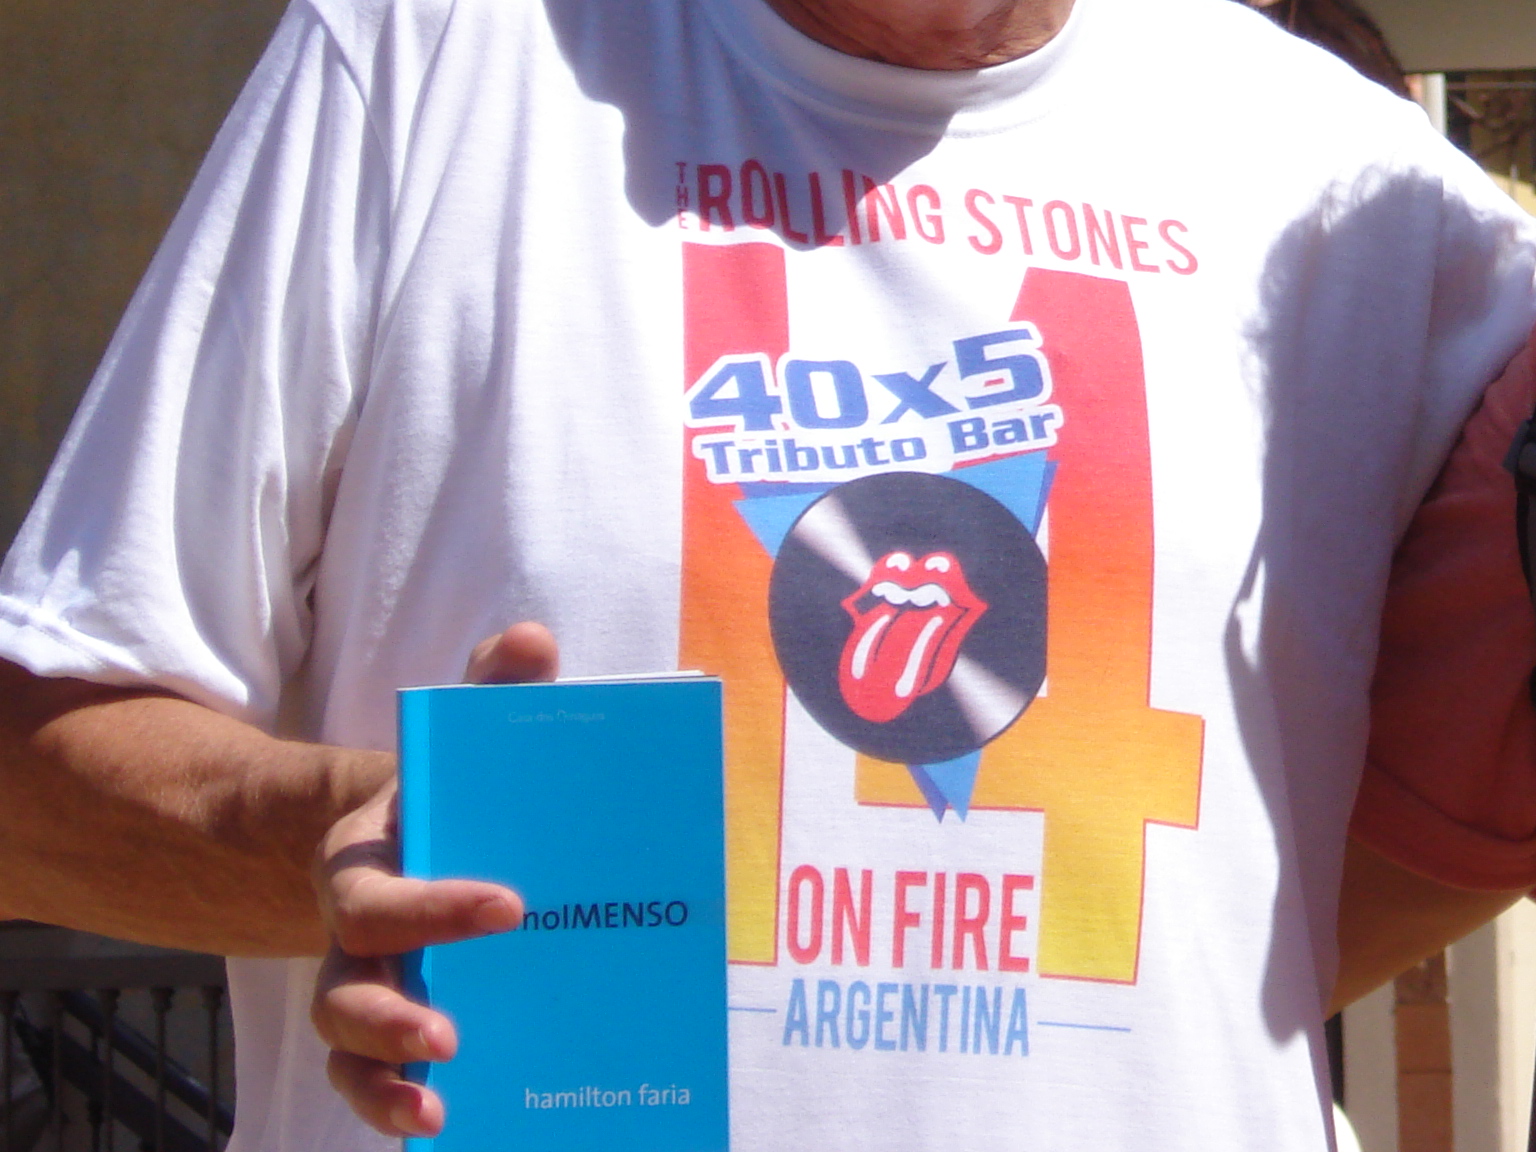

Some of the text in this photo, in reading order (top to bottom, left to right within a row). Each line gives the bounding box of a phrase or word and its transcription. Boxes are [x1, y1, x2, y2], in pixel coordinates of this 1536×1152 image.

[675, 158, 1199, 276] THE ROLLING STONES
[689, 328, 1045, 432] 40x5
[701, 408, 1056, 477] Tributo Bar
[512, 900, 689, 931] noIMENSO
[785, 863, 1035, 974] ON FIRE
[781, 977, 1031, 1057] ARGENTINA
[525, 1083, 691, 1110] hamilton faria
